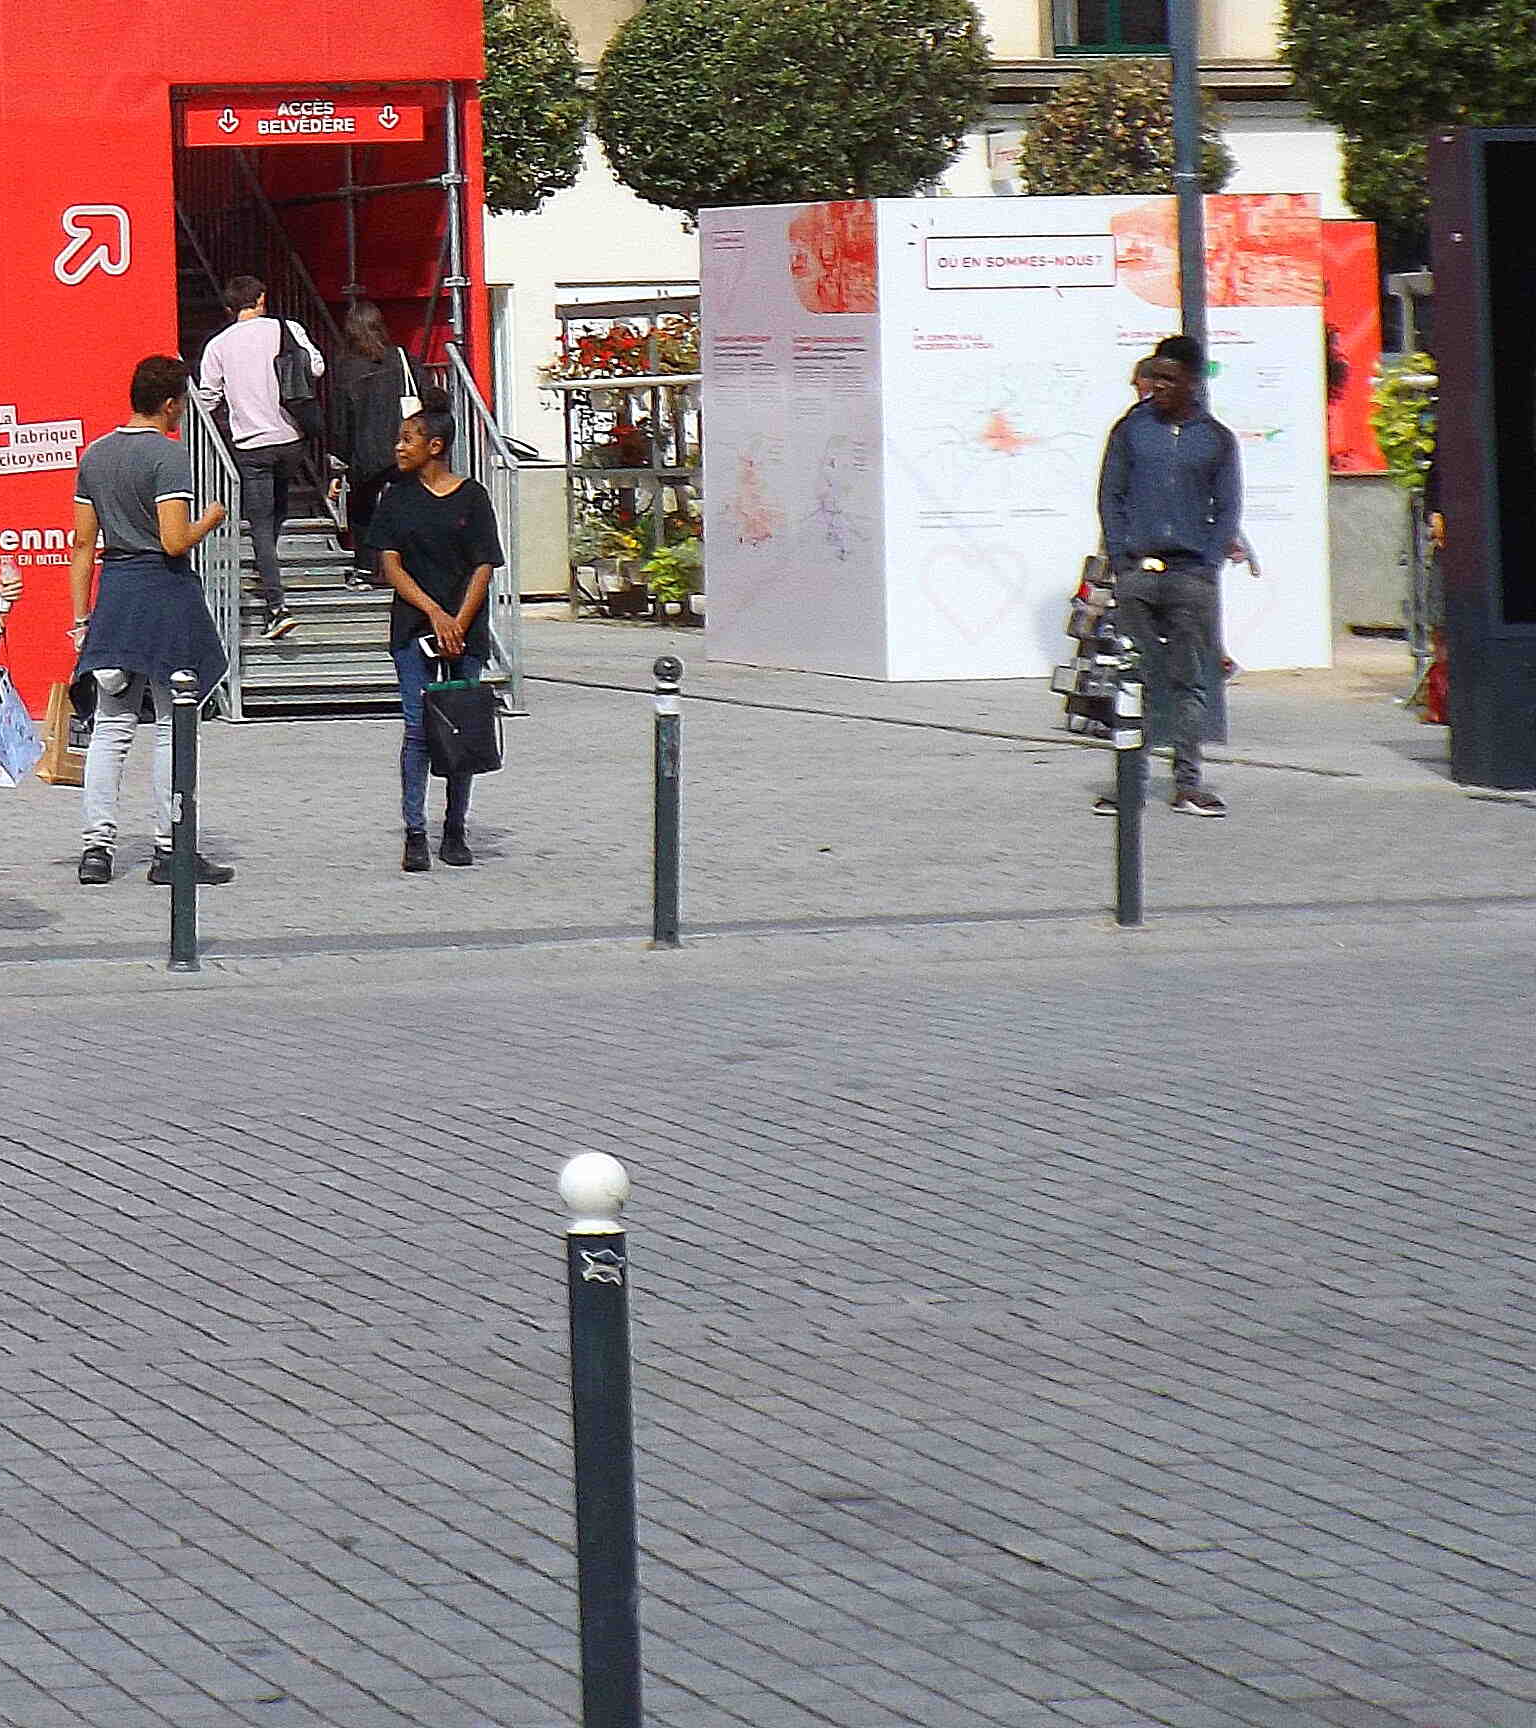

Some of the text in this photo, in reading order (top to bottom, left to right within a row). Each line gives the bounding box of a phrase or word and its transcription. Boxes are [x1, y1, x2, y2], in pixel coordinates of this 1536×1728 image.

[277, 101, 335, 118] ACCÈS
[257, 114, 356, 134] BELVÉDÈRE
[962, 257, 981, 268] EN
[14, 427, 78, 443] fabrique
